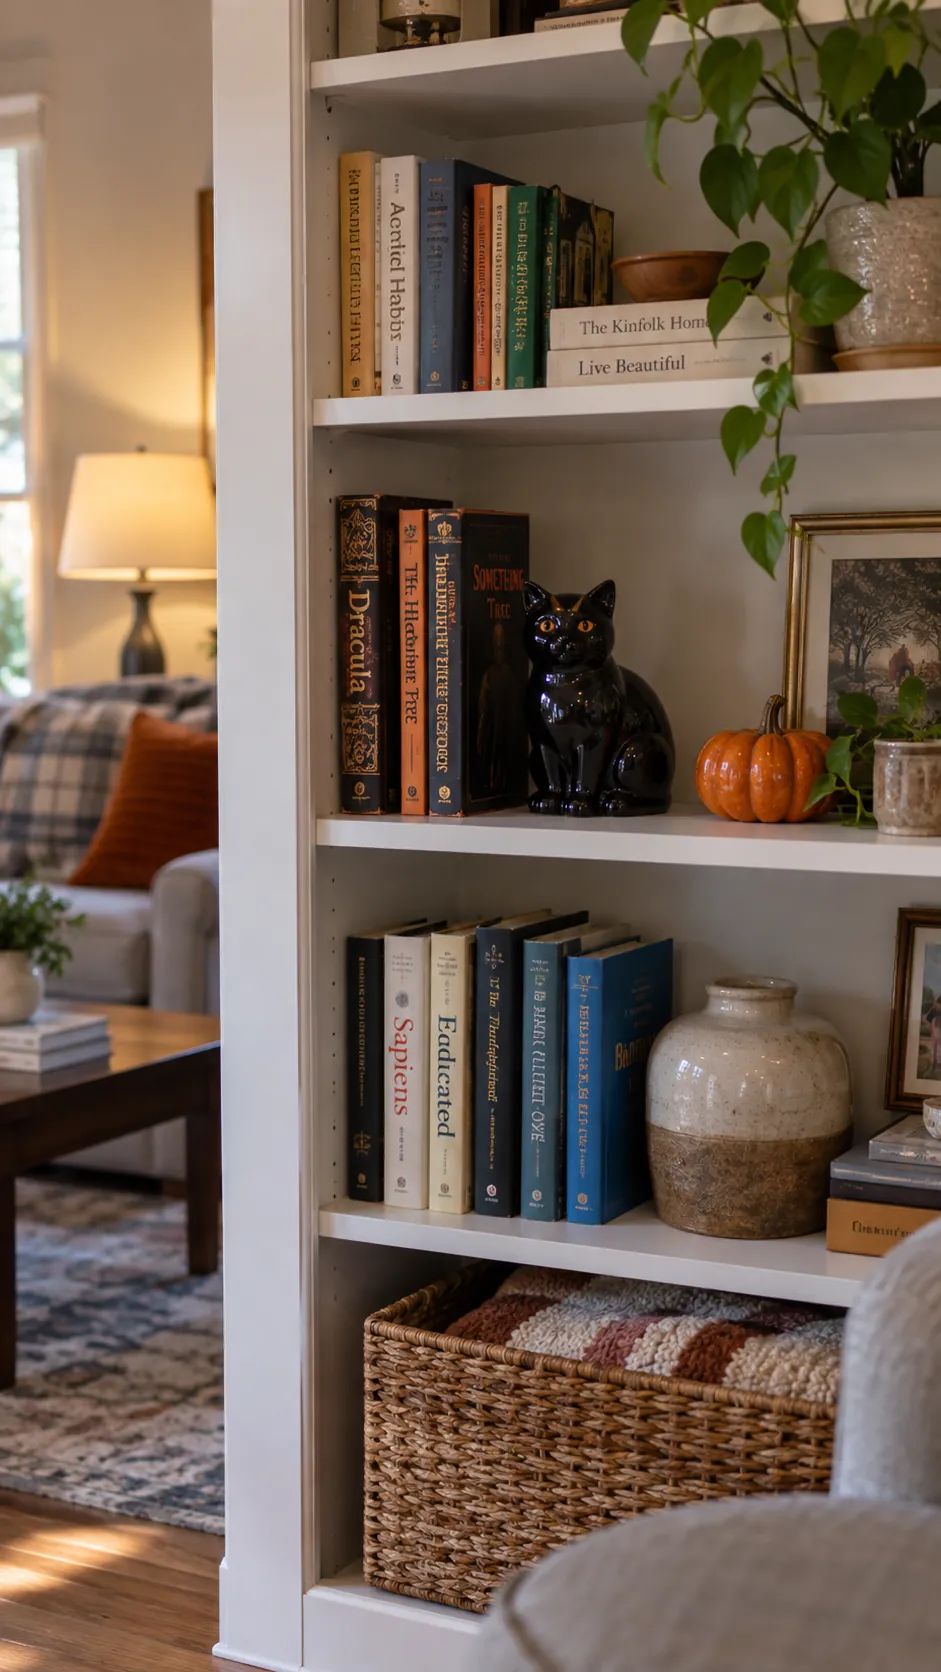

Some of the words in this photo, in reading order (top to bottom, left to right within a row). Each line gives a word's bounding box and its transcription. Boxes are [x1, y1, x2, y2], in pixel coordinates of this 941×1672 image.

[579, 320, 607, 335] The
[612, 316, 665, 334] Kinfolk
[578, 361, 611, 376] Live
[616, 355, 686, 374] Beautiful
[348, 589, 371, 693] Dracula
[388, 1017, 414, 1116] Sapiens
